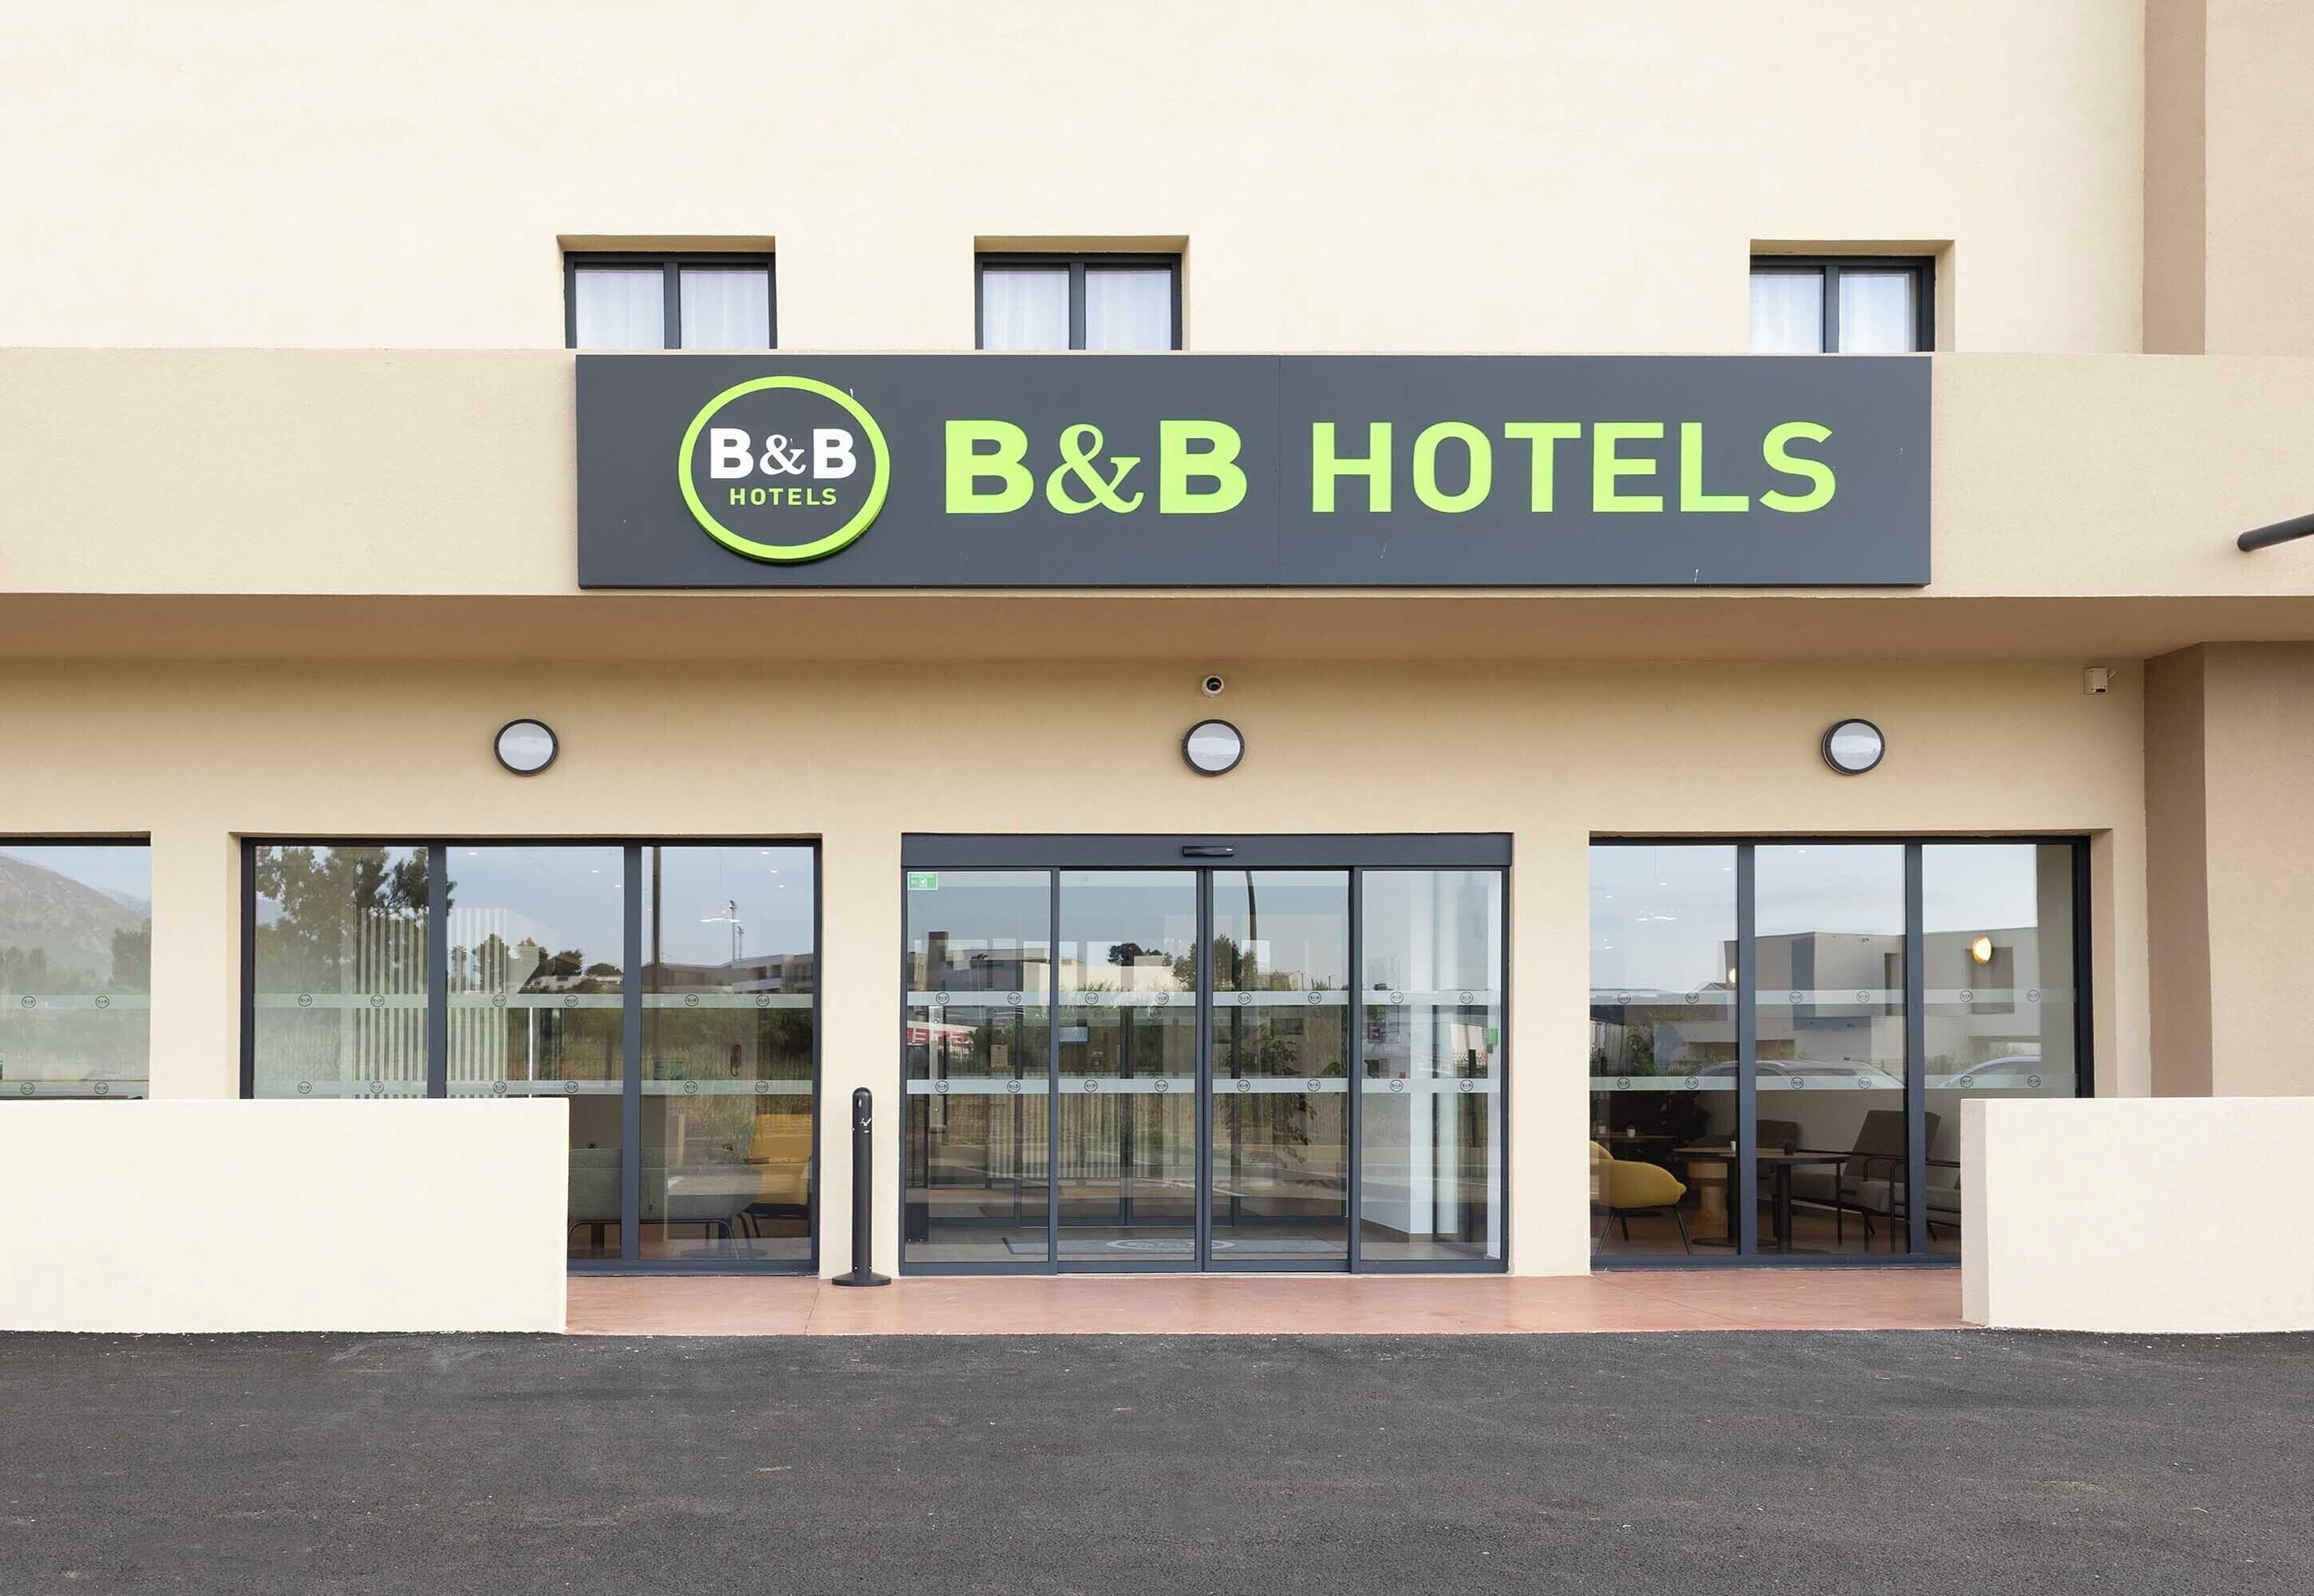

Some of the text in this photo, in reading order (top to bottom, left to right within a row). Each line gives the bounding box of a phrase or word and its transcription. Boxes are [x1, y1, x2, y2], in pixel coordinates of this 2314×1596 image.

[709, 427, 857, 480] B&B
[945, 420, 1837, 515] B&B HOTELS
[729, 488, 837, 506] HOTELS
